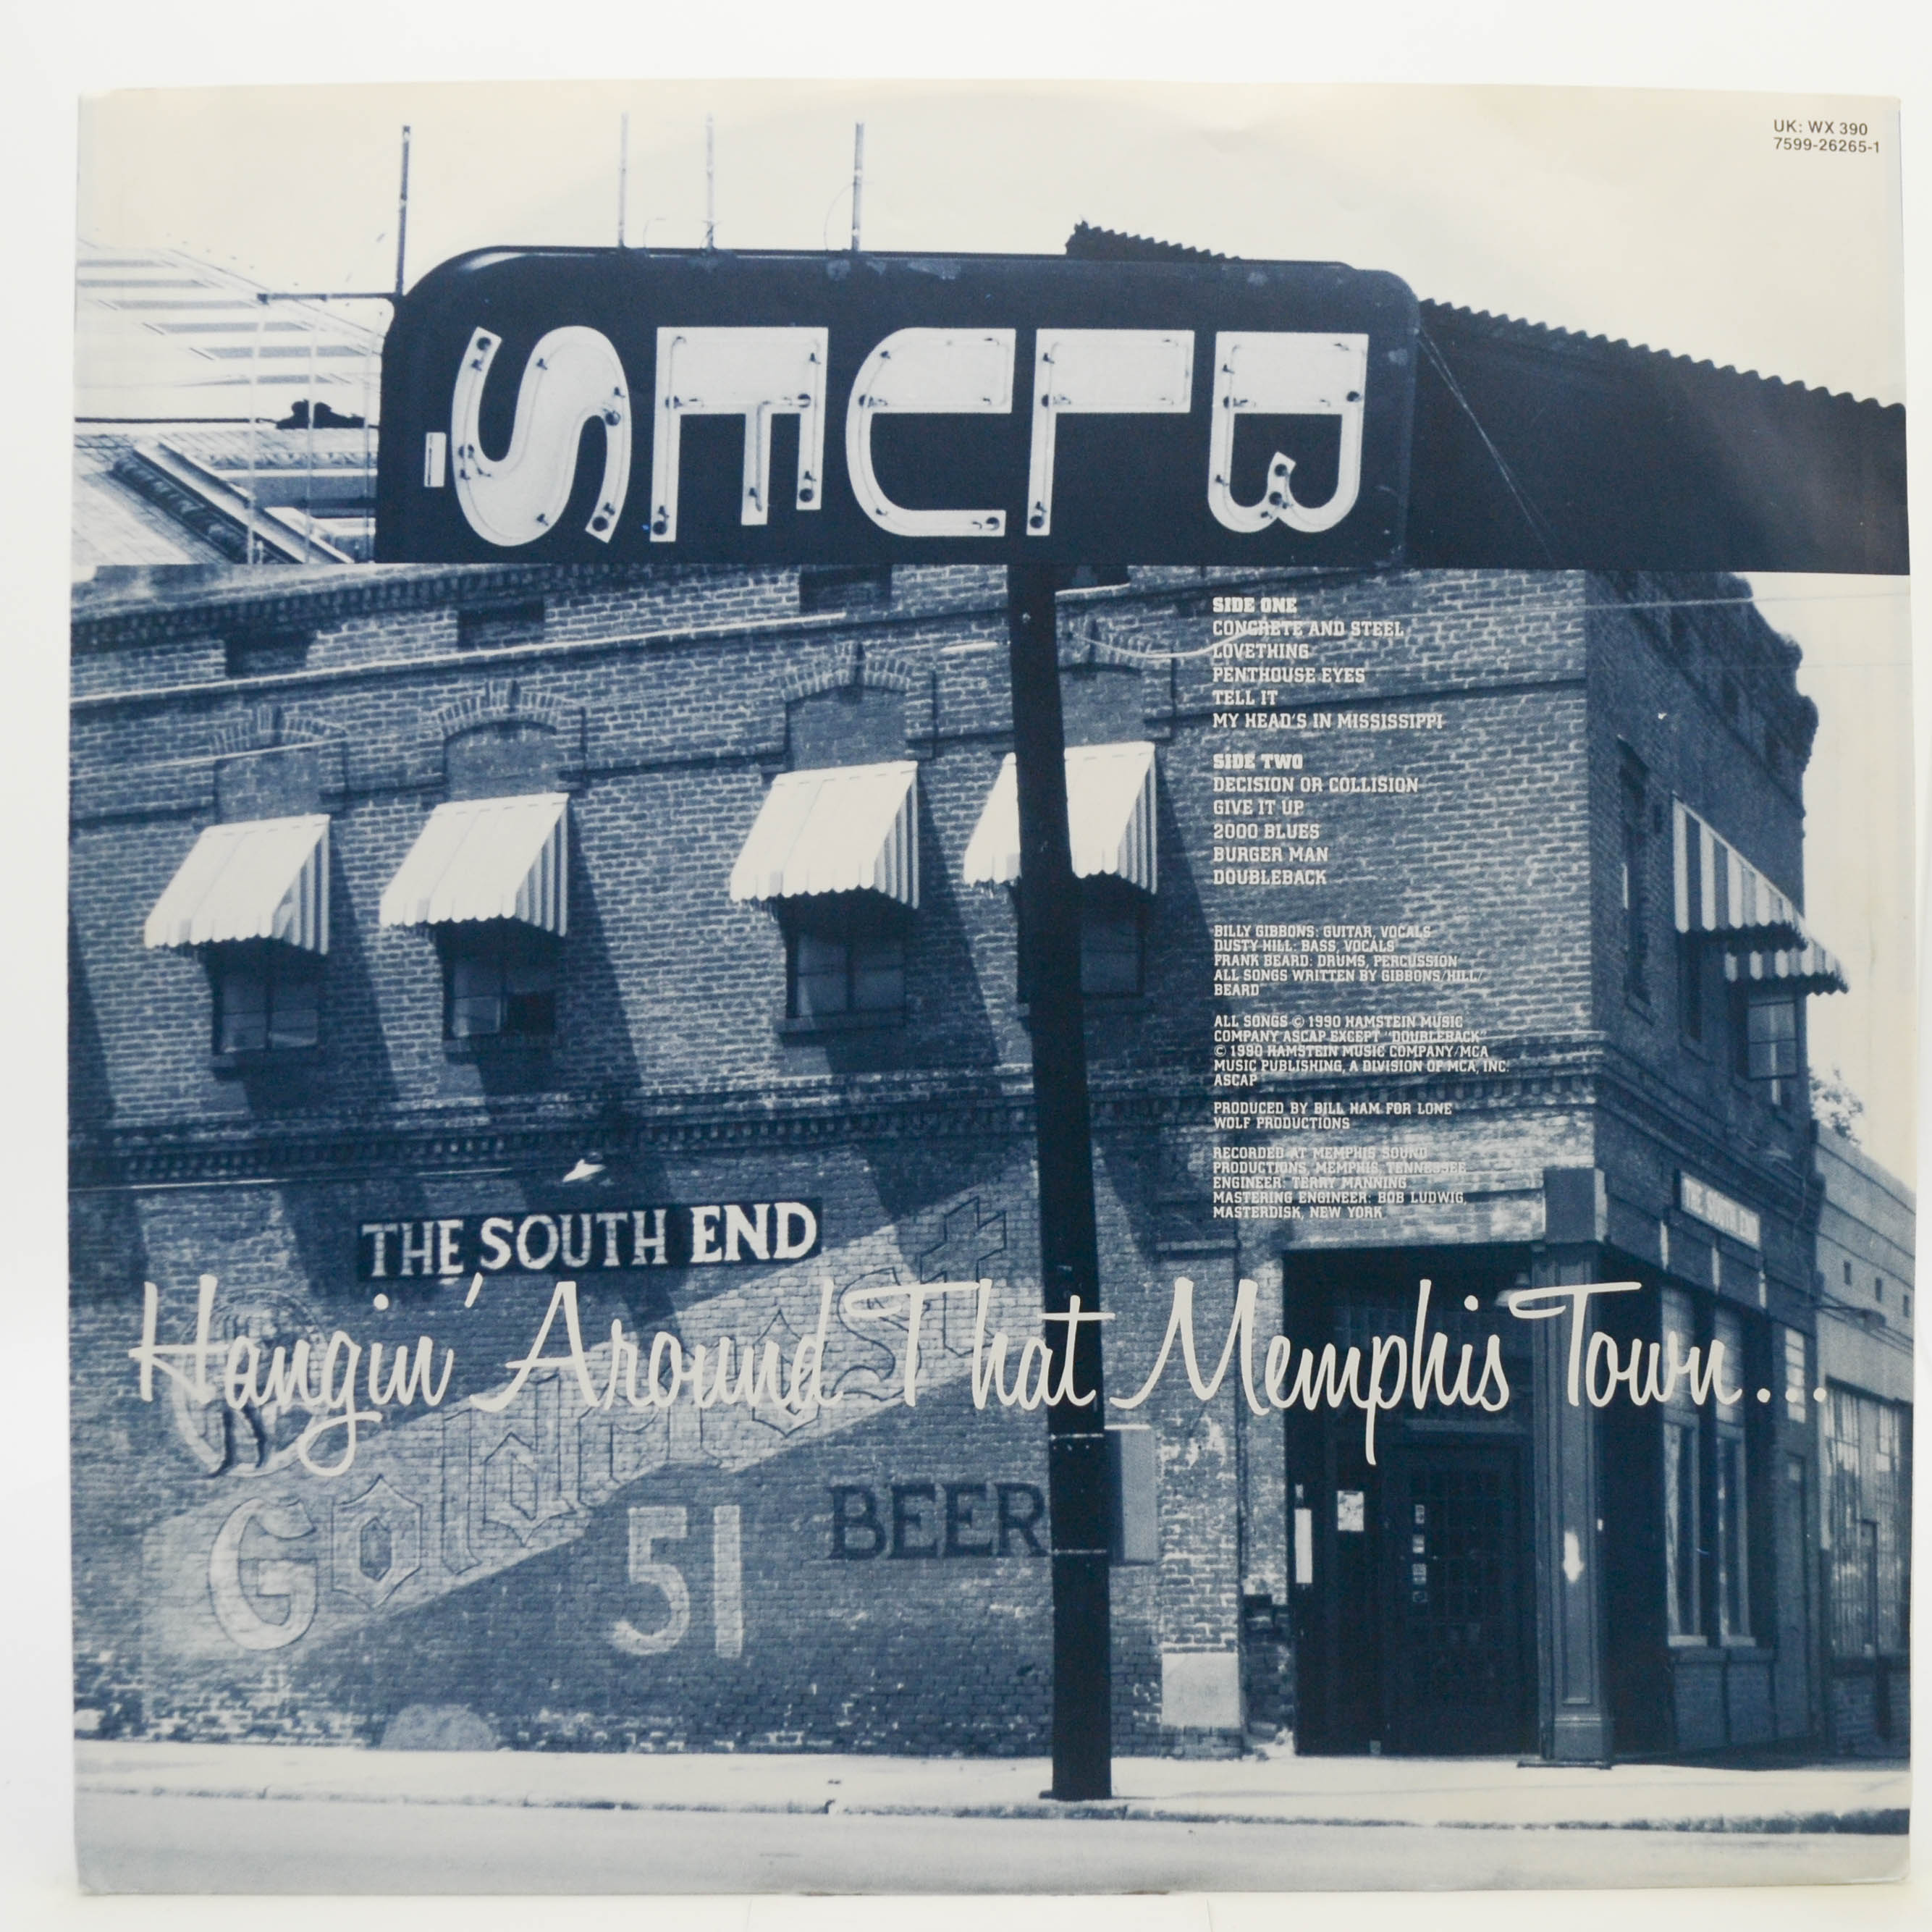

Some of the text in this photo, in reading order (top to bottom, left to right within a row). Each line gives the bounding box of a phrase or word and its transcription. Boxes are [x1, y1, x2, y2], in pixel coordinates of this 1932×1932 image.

[1773, 119, 1868, 135] UK: WX 390
[1773, 137, 1879, 153] 7599-26265-1
[450, 324, 1370, 547] BLUES
[1212, 596, 1297, 613] SIDE ONE
[1212, 620, 1404, 636] CONCRETE AND STEEL
[1212, 643, 1309, 659] LOVETHING
[1212, 667, 1365, 683] PENTHOUSE EYES
[1212, 690, 1278, 706] TELL IT
[1212, 713, 1443, 729] MY HEAD'S IN MISSISSIPPI
[1213, 754, 1304, 769] SIDE TWO
[1213, 777, 1418, 793] DECISION OR COLLISION
[1213, 800, 1304, 816] GIVE IT UP
[1213, 823, 1320, 840] 2000 BLUES
[1213, 846, 1328, 862] BURGER MAN
[1213, 869, 1327, 885] DOUBLEBACK
[1214, 925, 1431, 939] BILLY GIBBONS: GUITAR, VOCALS
[1214, 940, 1394, 954] DUSTY HILL: BASS, VOCALS
[1214, 954, 1458, 969] FRANK BEARD: DRUMS, PERCUSSION
[1214, 969, 1483, 982] ALL SONGS WRITTEN BY GIBBONS/HILL/
[1214, 984, 1260, 997] BEARD
[1214, 1015, 1464, 1028] ALL SONGS © 1990 HAMSTEIN MUSIC
[1214, 1030, 1278, 1043] COMPANY
[1283, 1030, 1326, 1043] ASCAP
[1330, 1030, 1379, 1043] EXCEPT
[1214, 1045, 1489, 1058] © 1990 HAMSTEIN MUSIC COMPANY/MCA
[1214, 1060, 1510, 1074] MUSIC PUBLISHING, A DIVISION OF MCA, INC.
[1214, 1074, 1258, 1087] ASCAP
[1214, 1102, 1452, 1115] PRODUCED BY BILL HAM FOR LONE
[1214, 1117, 1351, 1130] WOLF PRODUCTIONS
[1212, 1147, 1427, 1159] RECORDED AT MEMPHIS SOUND
[1213, 1162, 1309, 1176] PRODUCTIONS,
[1385, 1162, 1467, 1174] TENNESSEE
[1213, 1176, 1407, 1189] ENGINEER: TERRY MANNING
[1213, 1191, 1467, 1205] MASTERING ENGINEER: BOB LUDWIG,
[1213, 1206, 1383, 1220] MASTERDISK, NEW YORK
[363, 1202, 817, 1277] THE SOUTH END
[128, 1273, 484, 1477] Hangin'
[471, 1279, 845, 1413] Around
[845, 1278, 1115, 1411] That
[1109, 1277, 1511, 1466] Memphis
[826, 1481, 1052, 1562] BEER
[608, 1504, 745, 1661] 51
